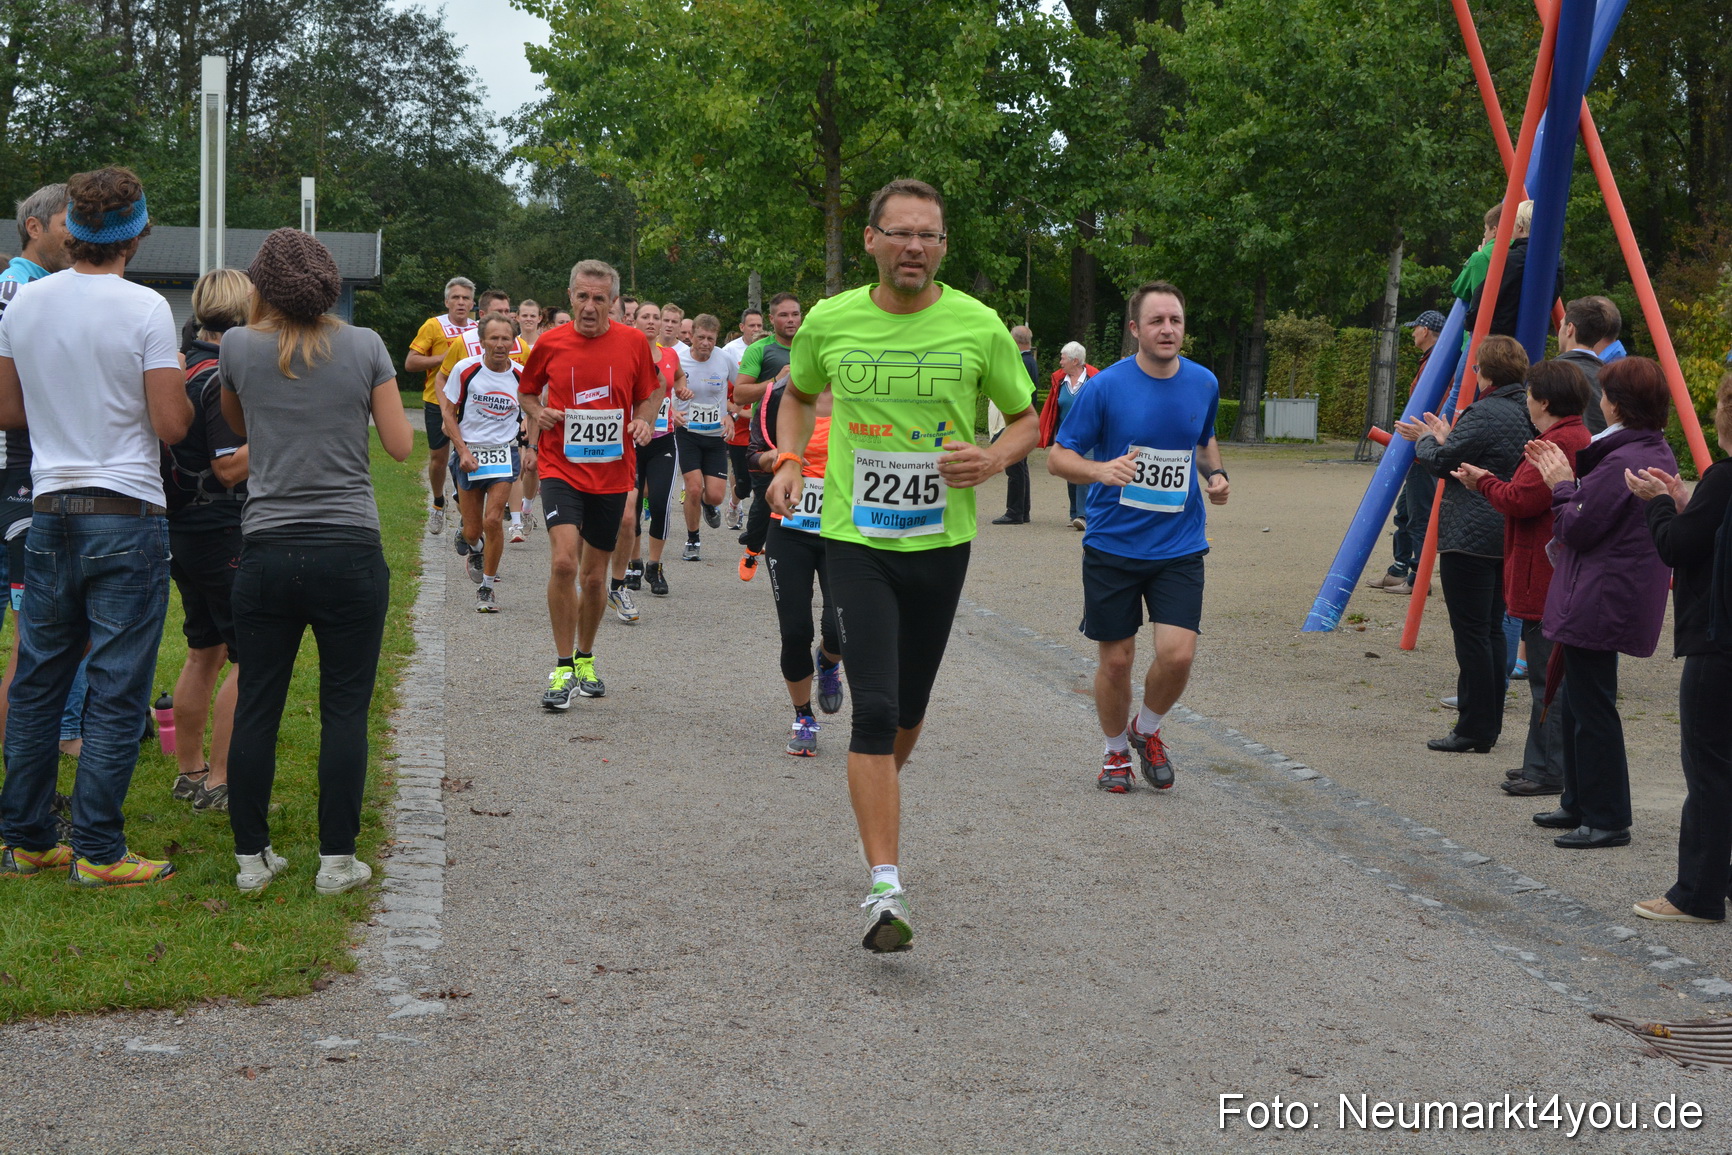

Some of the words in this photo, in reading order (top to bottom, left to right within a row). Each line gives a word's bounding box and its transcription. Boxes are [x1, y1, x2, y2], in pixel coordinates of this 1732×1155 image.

[838, 349, 962, 396] OPF
[472, 393, 510, 405] GERHART
[566, 413, 585, 421] PARTL
[692, 410, 718, 423] 2116
[570, 422, 618, 443] 2492
[849, 421, 893, 437] MERZ
[912, 430, 956, 440] Bretschneider
[583, 447, 605, 456] Franz
[856, 457, 887, 469] PARTL
[889, 460, 934, 470] Neumarkt
[1153, 455, 1182, 463] Neumarkt
[1132, 460, 1185, 489] 3365
[863, 471, 940, 506] 2245
[871, 511, 927, 530] Wolfgang
[771, 569, 780, 602] odlo
